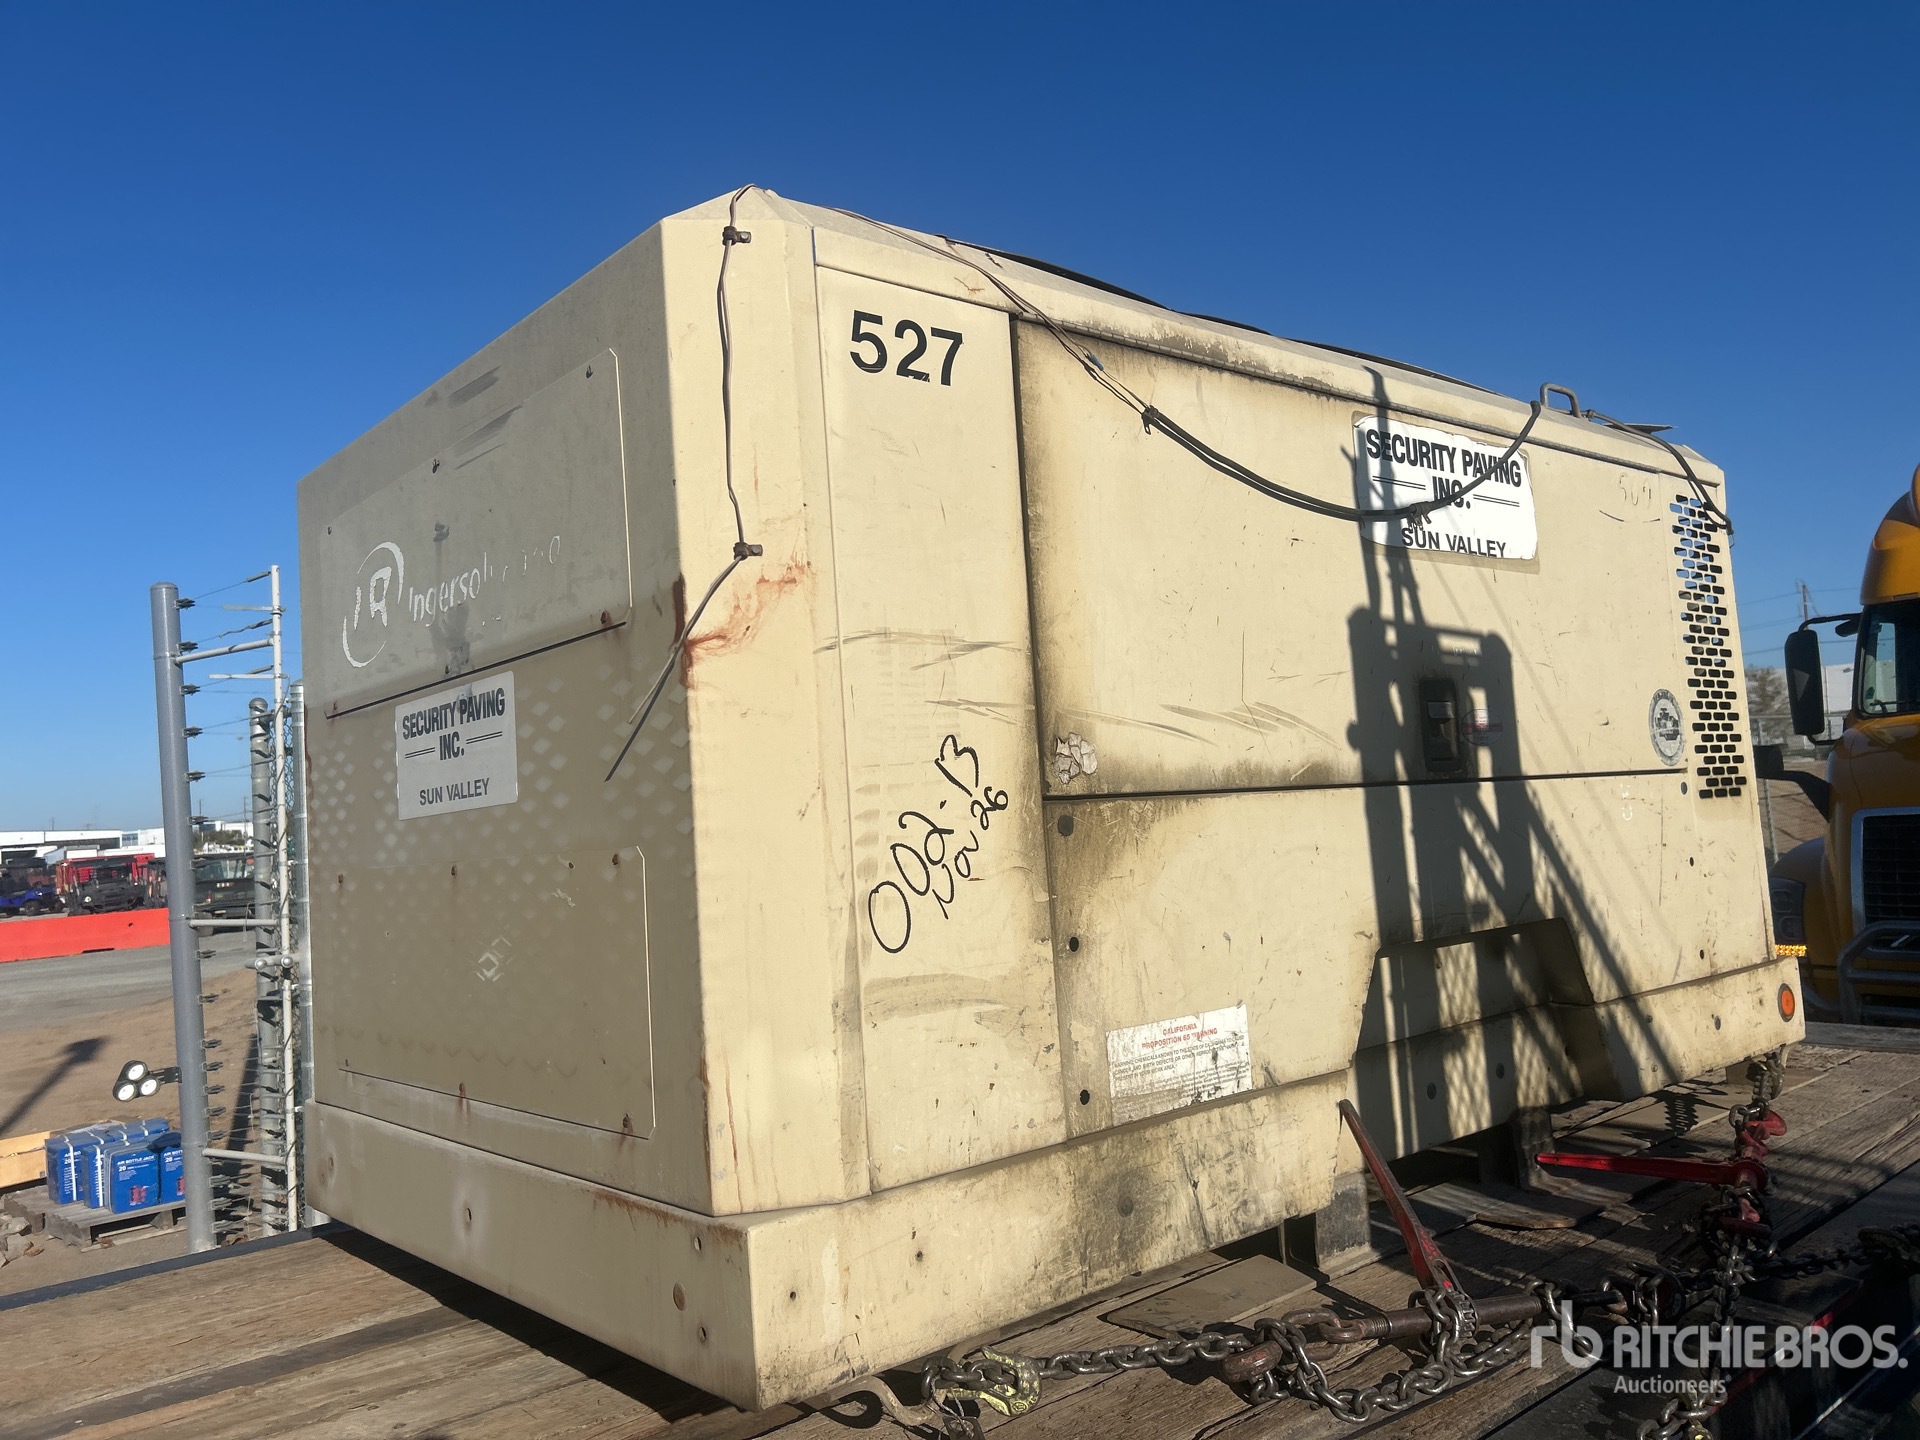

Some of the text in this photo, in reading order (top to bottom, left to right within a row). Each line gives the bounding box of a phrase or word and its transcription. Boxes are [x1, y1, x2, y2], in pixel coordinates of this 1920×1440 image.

[850, 310, 964, 387] 527
[1366, 429, 1522, 488] SECURITY PAVING
[1432, 476, 1471, 509] INC.
[1402, 528, 1507, 558] SUN VALLEY
[408, 551, 493, 628] Ingersol
[402, 687, 506, 740] SECURITY PAVING
[439, 731, 465, 761] INC.
[419, 777, 490, 806] SUN VALLEY
[970, 785, 1009, 831] 26
[1141, 1036, 1182, 1049] PROPOSITION
[1182, 1033, 1191, 1041] 65
[1162, 1023, 1198, 1036] CALIFORNIA
[125, 1157, 143, 1165] BOTTLE
